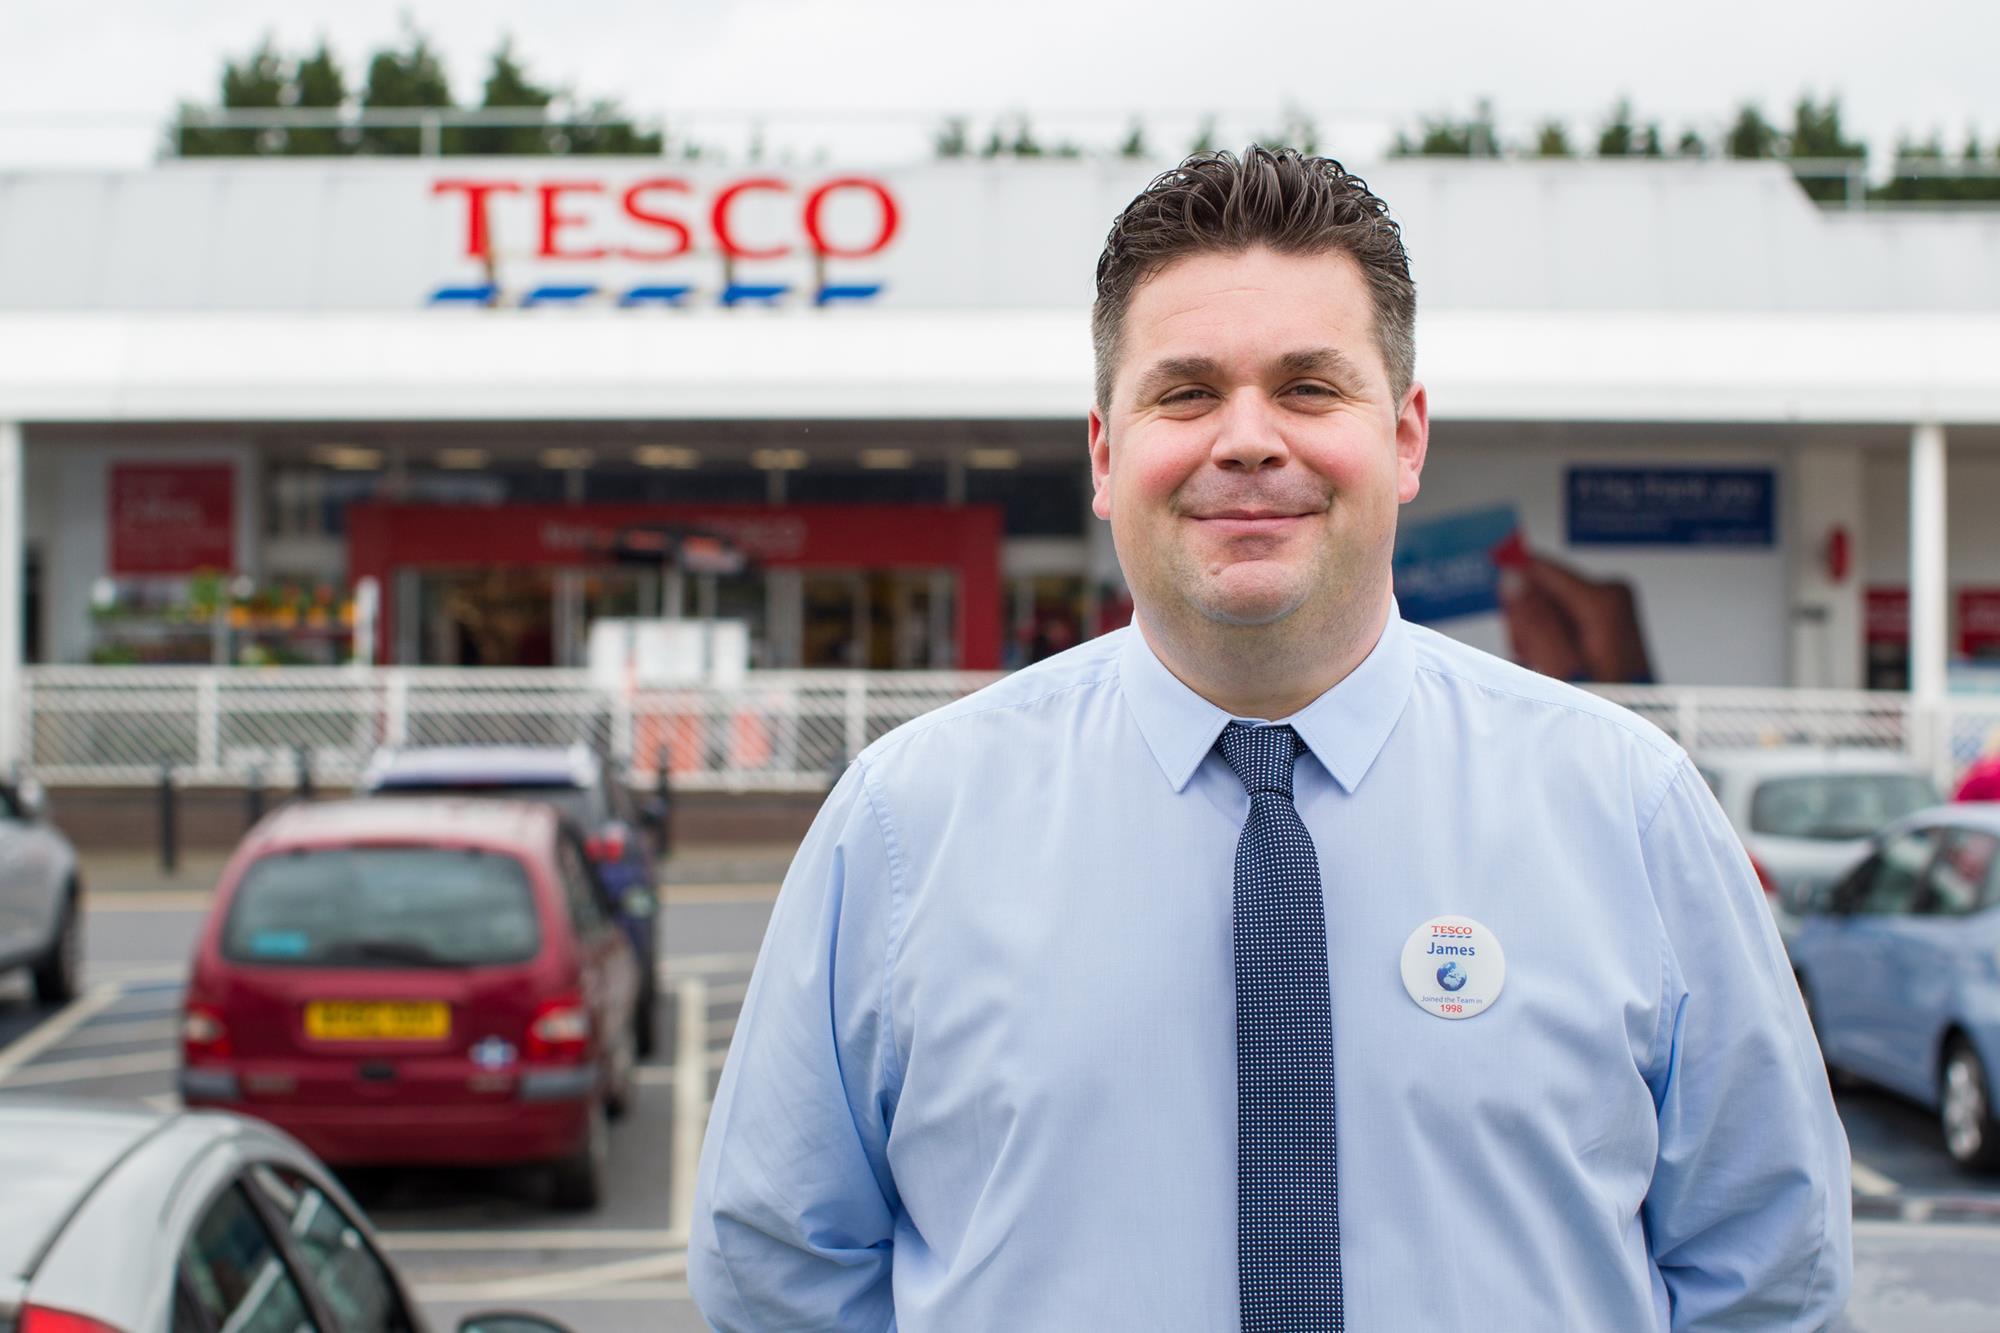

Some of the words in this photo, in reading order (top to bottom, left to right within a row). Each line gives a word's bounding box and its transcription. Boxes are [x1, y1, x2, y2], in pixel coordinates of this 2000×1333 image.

[432, 176, 901, 261] TESCO
[1432, 926, 1472, 934] TESCO
[1427, 942, 1475, 956] James
[1421, 995, 1444, 1003] Joined
[1456, 996, 1475, 1004] Team
[1440, 1004, 1462, 1013] 1998
